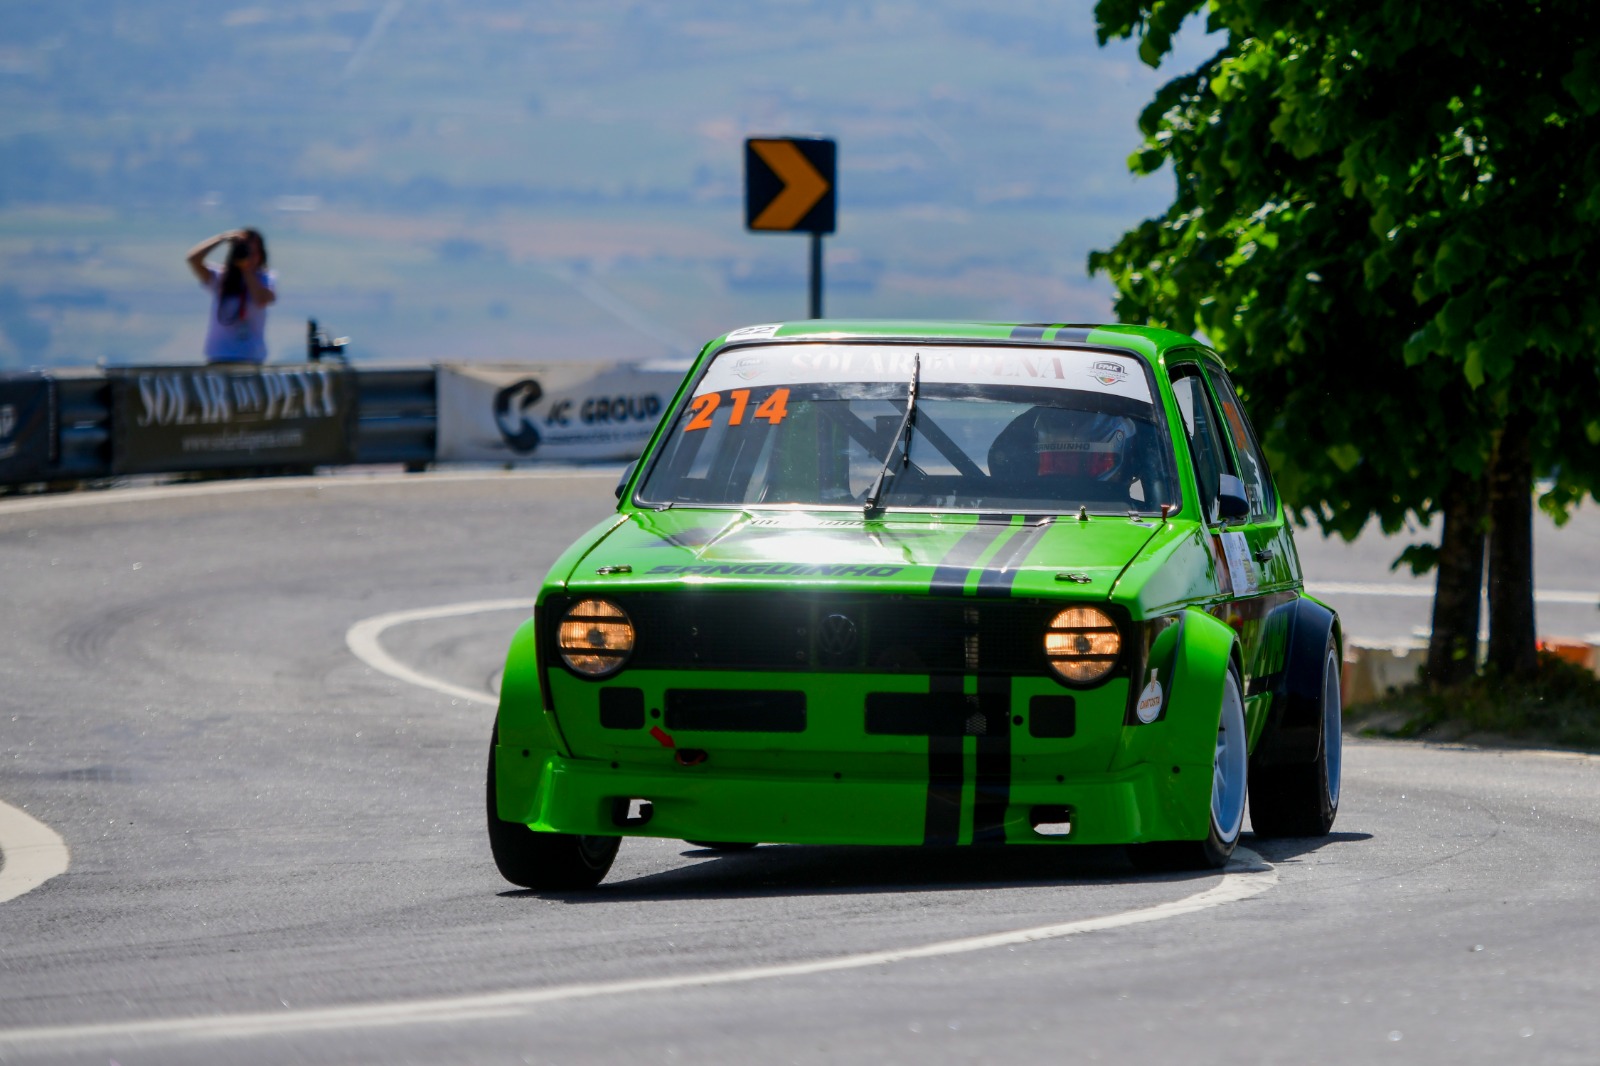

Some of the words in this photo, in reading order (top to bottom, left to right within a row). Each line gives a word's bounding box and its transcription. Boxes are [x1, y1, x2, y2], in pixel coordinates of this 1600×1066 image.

[580, 395, 662, 424] GROUP
[684, 388, 790, 432] 214
[1037, 442, 1091, 451] ANGUINHO
[645, 564, 904, 577] SANGUINHO
